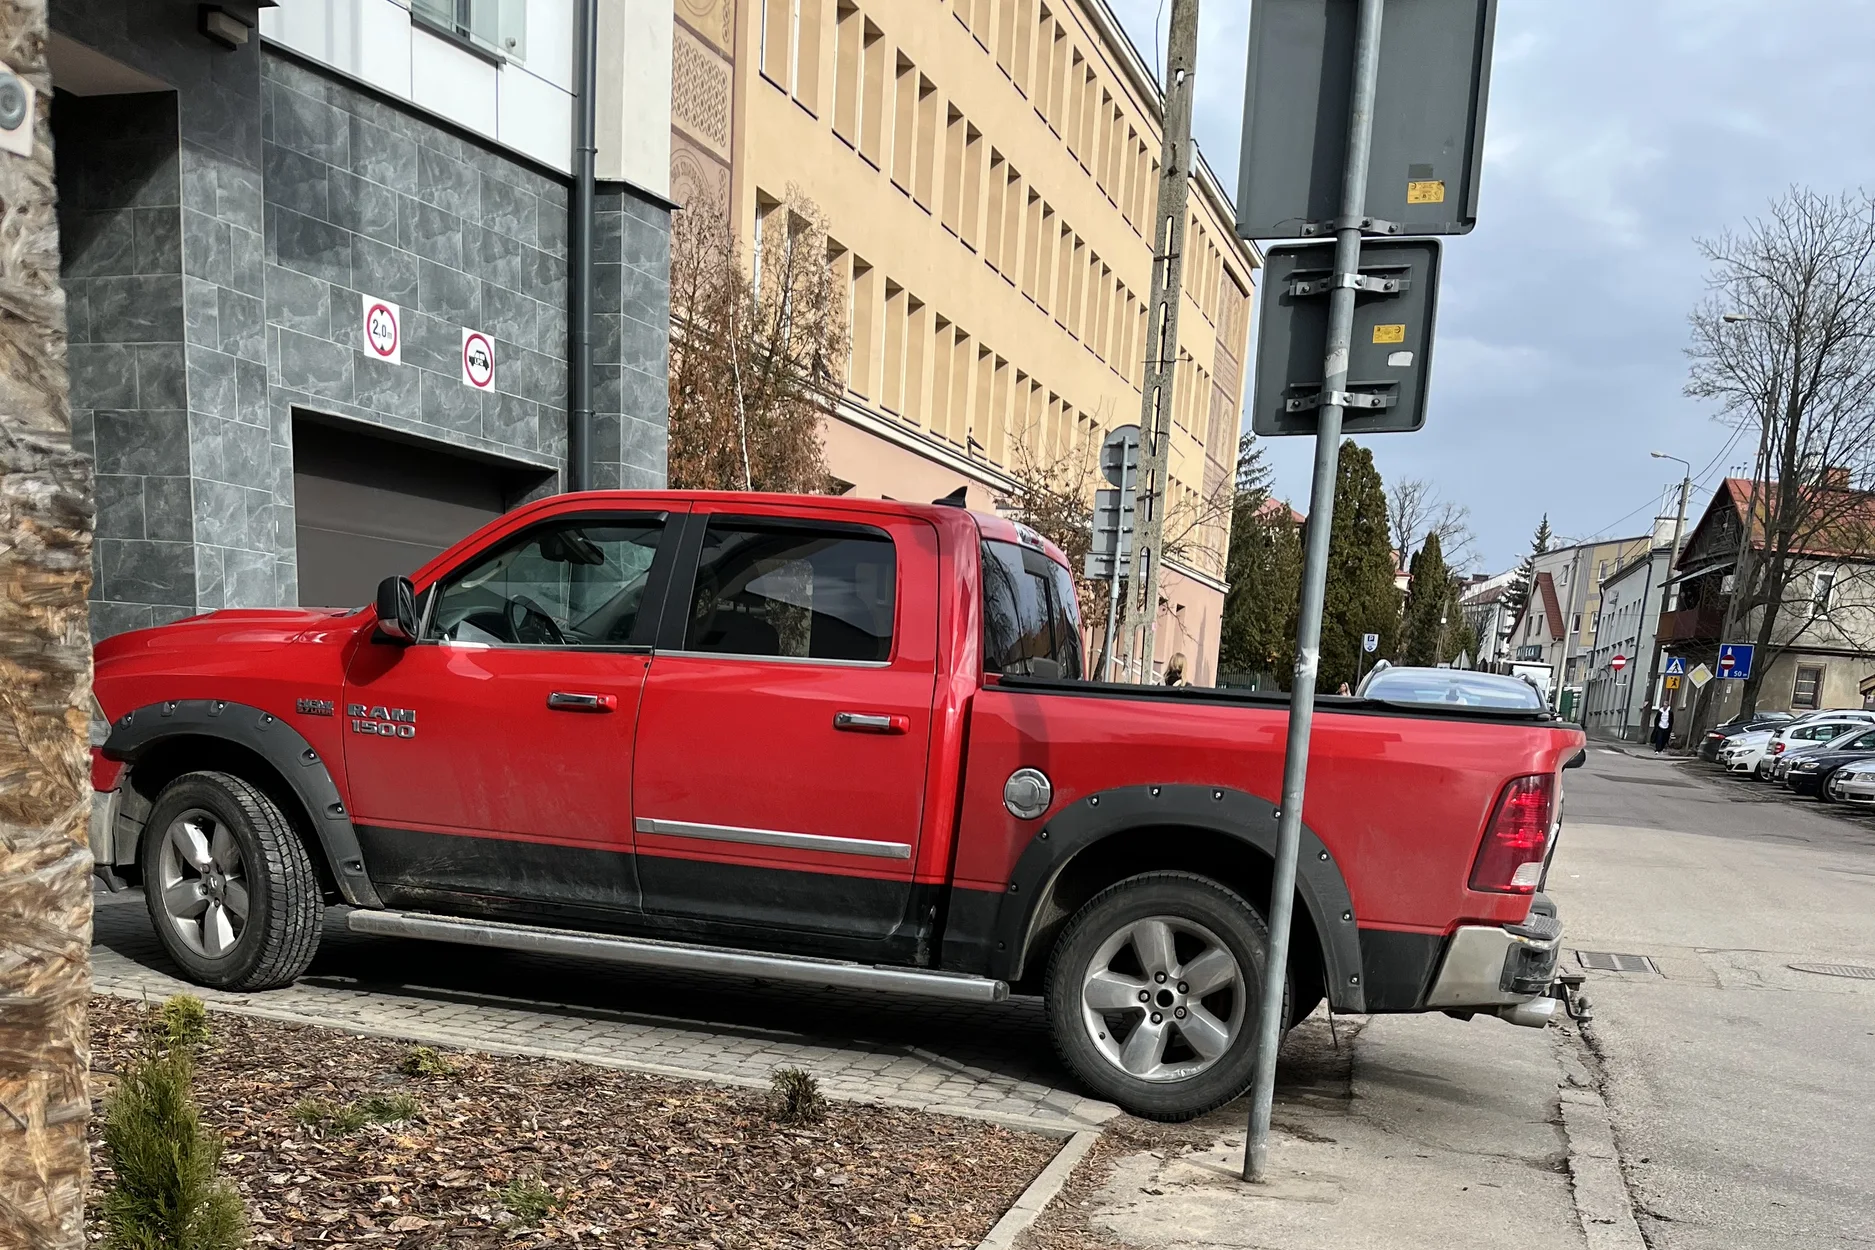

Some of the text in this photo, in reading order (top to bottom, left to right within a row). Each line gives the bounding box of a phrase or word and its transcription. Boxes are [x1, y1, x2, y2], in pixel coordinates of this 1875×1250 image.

[297, 698, 334, 710] HEMI
[347, 703, 416, 722] RAM
[352, 720, 416, 739] 1500
